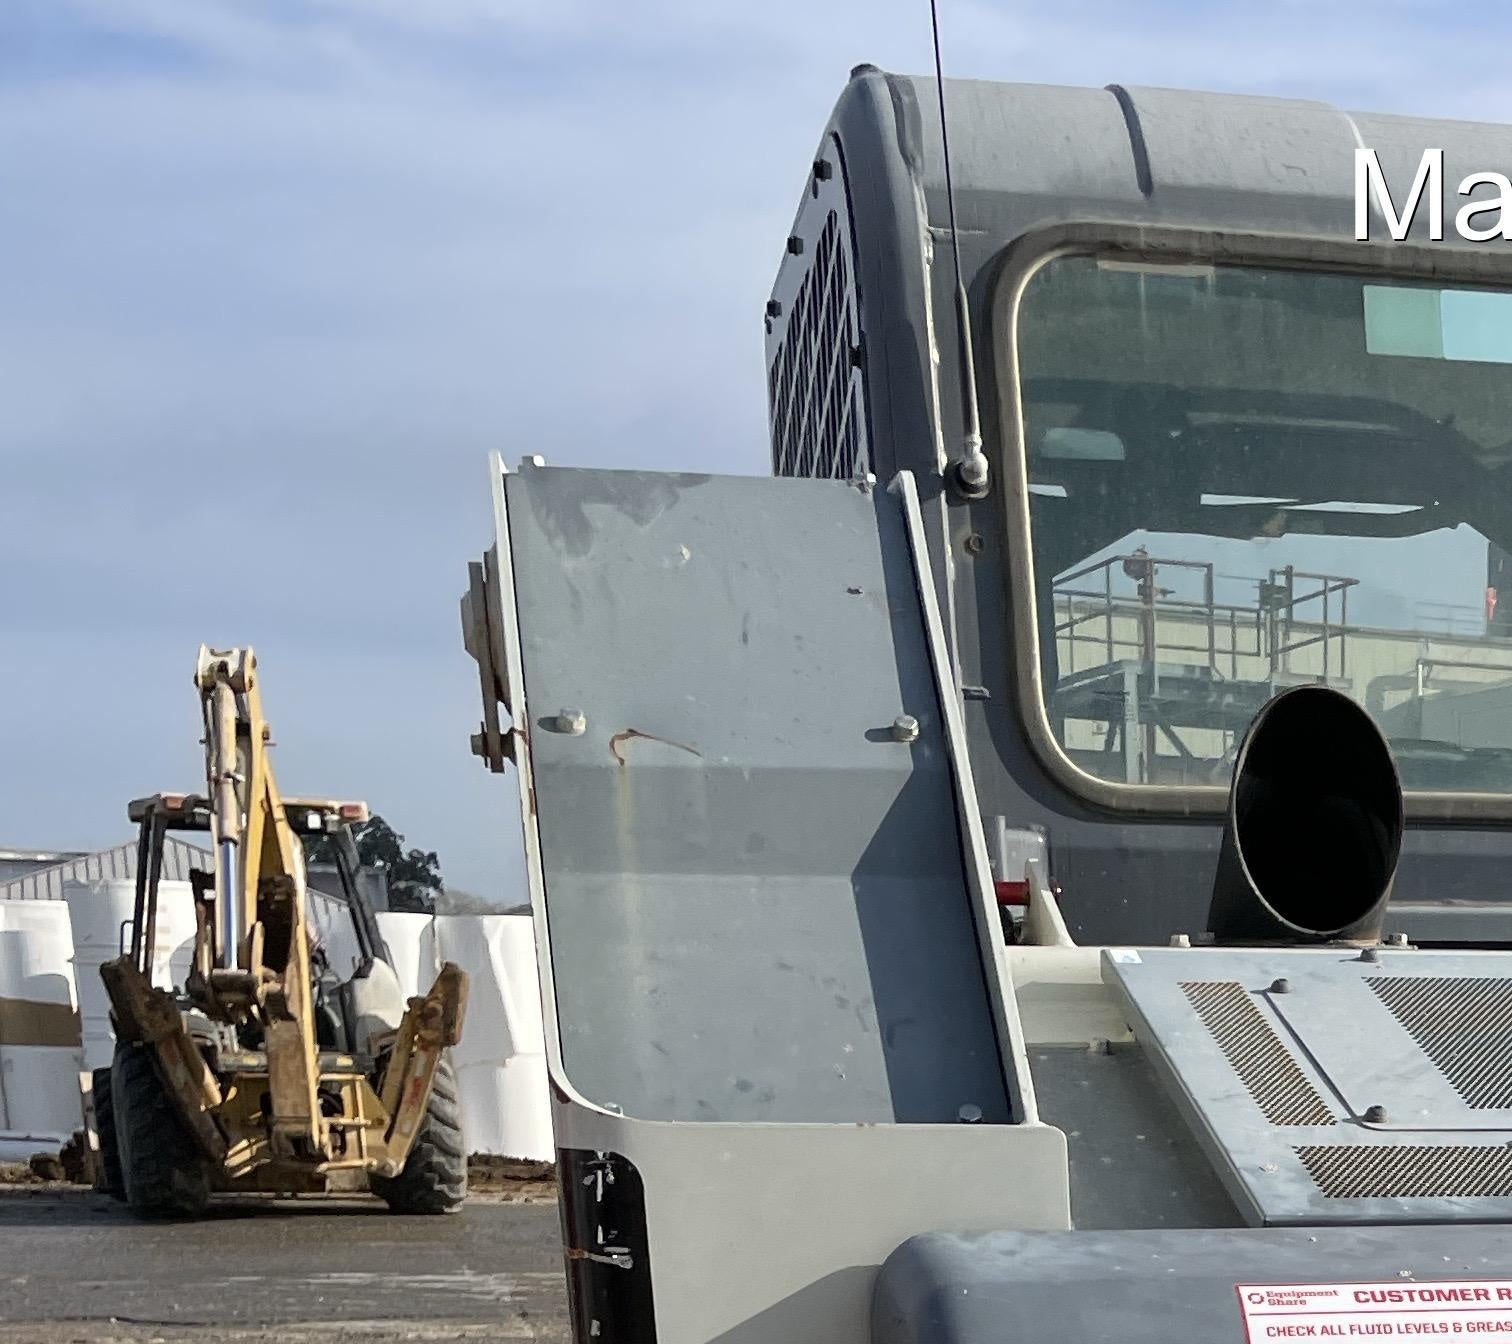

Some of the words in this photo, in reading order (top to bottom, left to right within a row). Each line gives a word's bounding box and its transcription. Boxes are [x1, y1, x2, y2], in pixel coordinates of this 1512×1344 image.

[1266, 1289, 1339, 1299] Equipment
[1353, 1288, 1491, 1304] CUSTOMER
[1266, 1325, 1317, 1337] CHECK
[1320, 1324, 1346, 1336] ALL
[1349, 1323, 1393, 1335] FLUID
[1397, 1322, 1449, 1334] LEVELS
[1453, 1321, 1463, 1333] &
